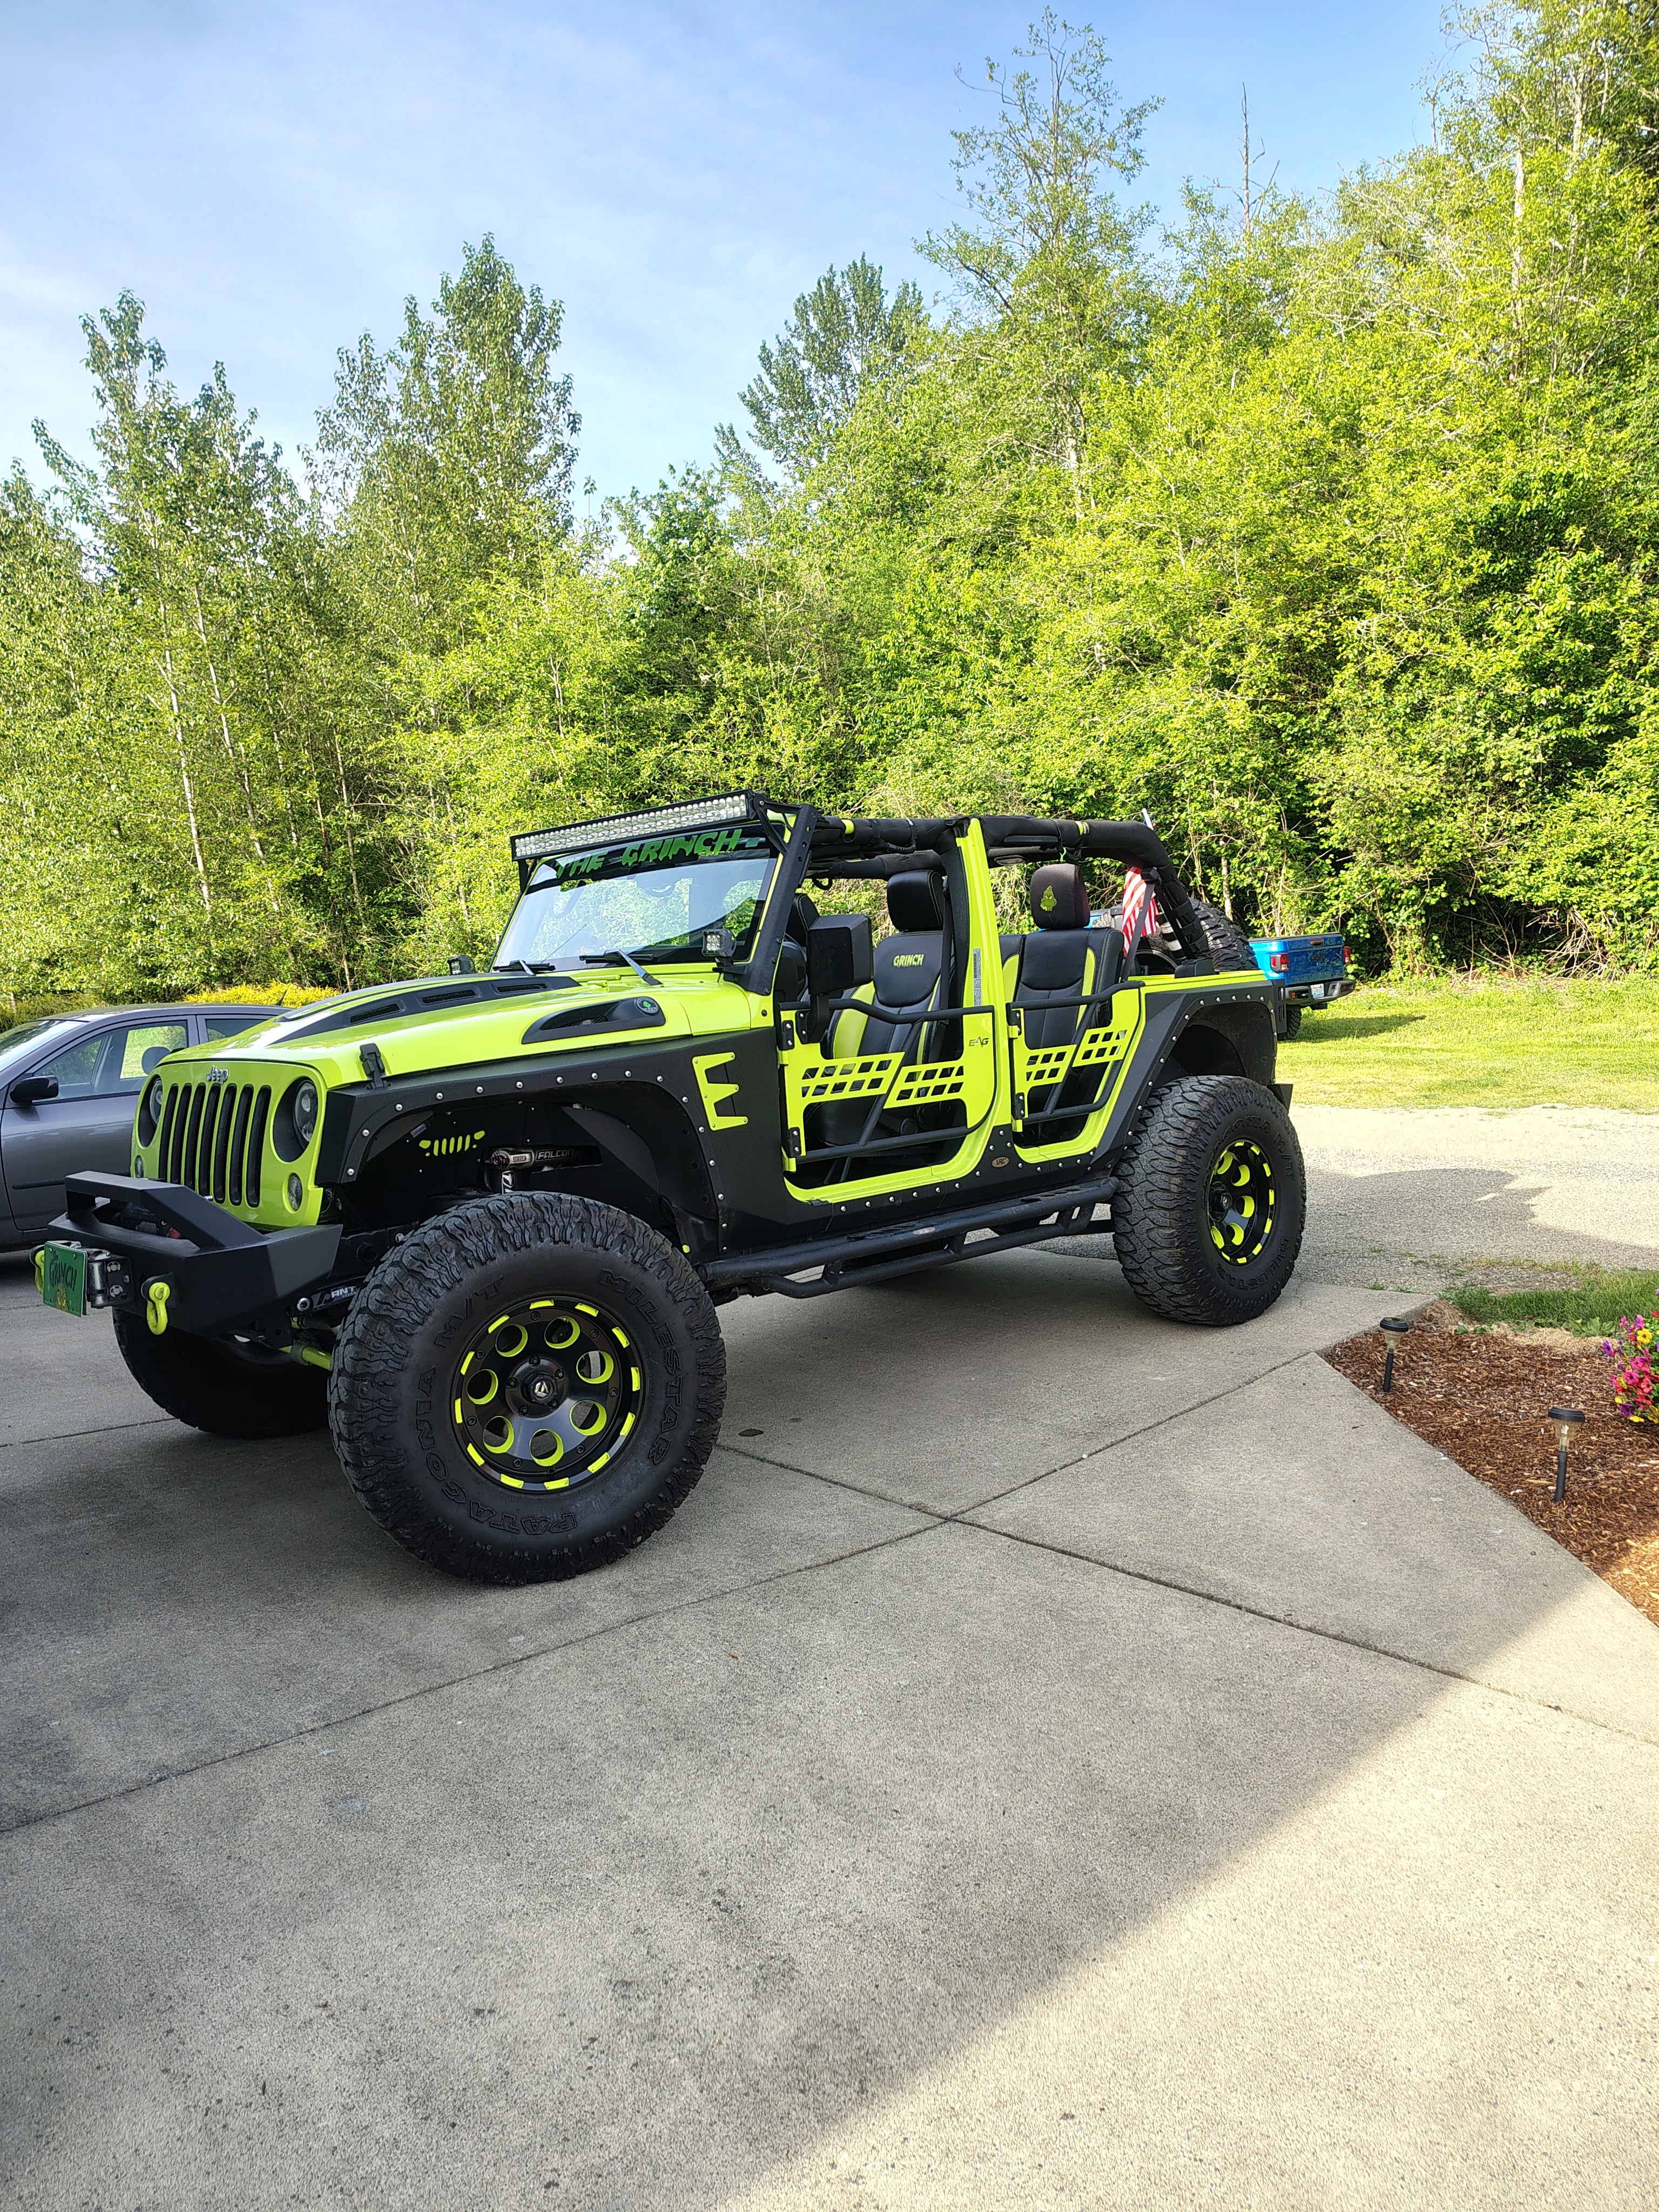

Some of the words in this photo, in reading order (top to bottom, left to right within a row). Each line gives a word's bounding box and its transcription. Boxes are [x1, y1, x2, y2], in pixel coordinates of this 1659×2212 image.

[555, 850, 609, 879] THE
[621, 828, 743, 867] GRINCH
[893, 954, 924, 968] GRINCH
[969, 1036, 989, 1047] EAG
[206, 1064, 229, 1085] Jeep
[537, 1149, 575, 1160] FALCON
[49, 1260, 77, 1291] GRINCH
[434, 1273, 504, 1348] M/T
[598, 1267, 683, 1466] MILESTAR
[416, 1364, 577, 1535] PATAGONIA
